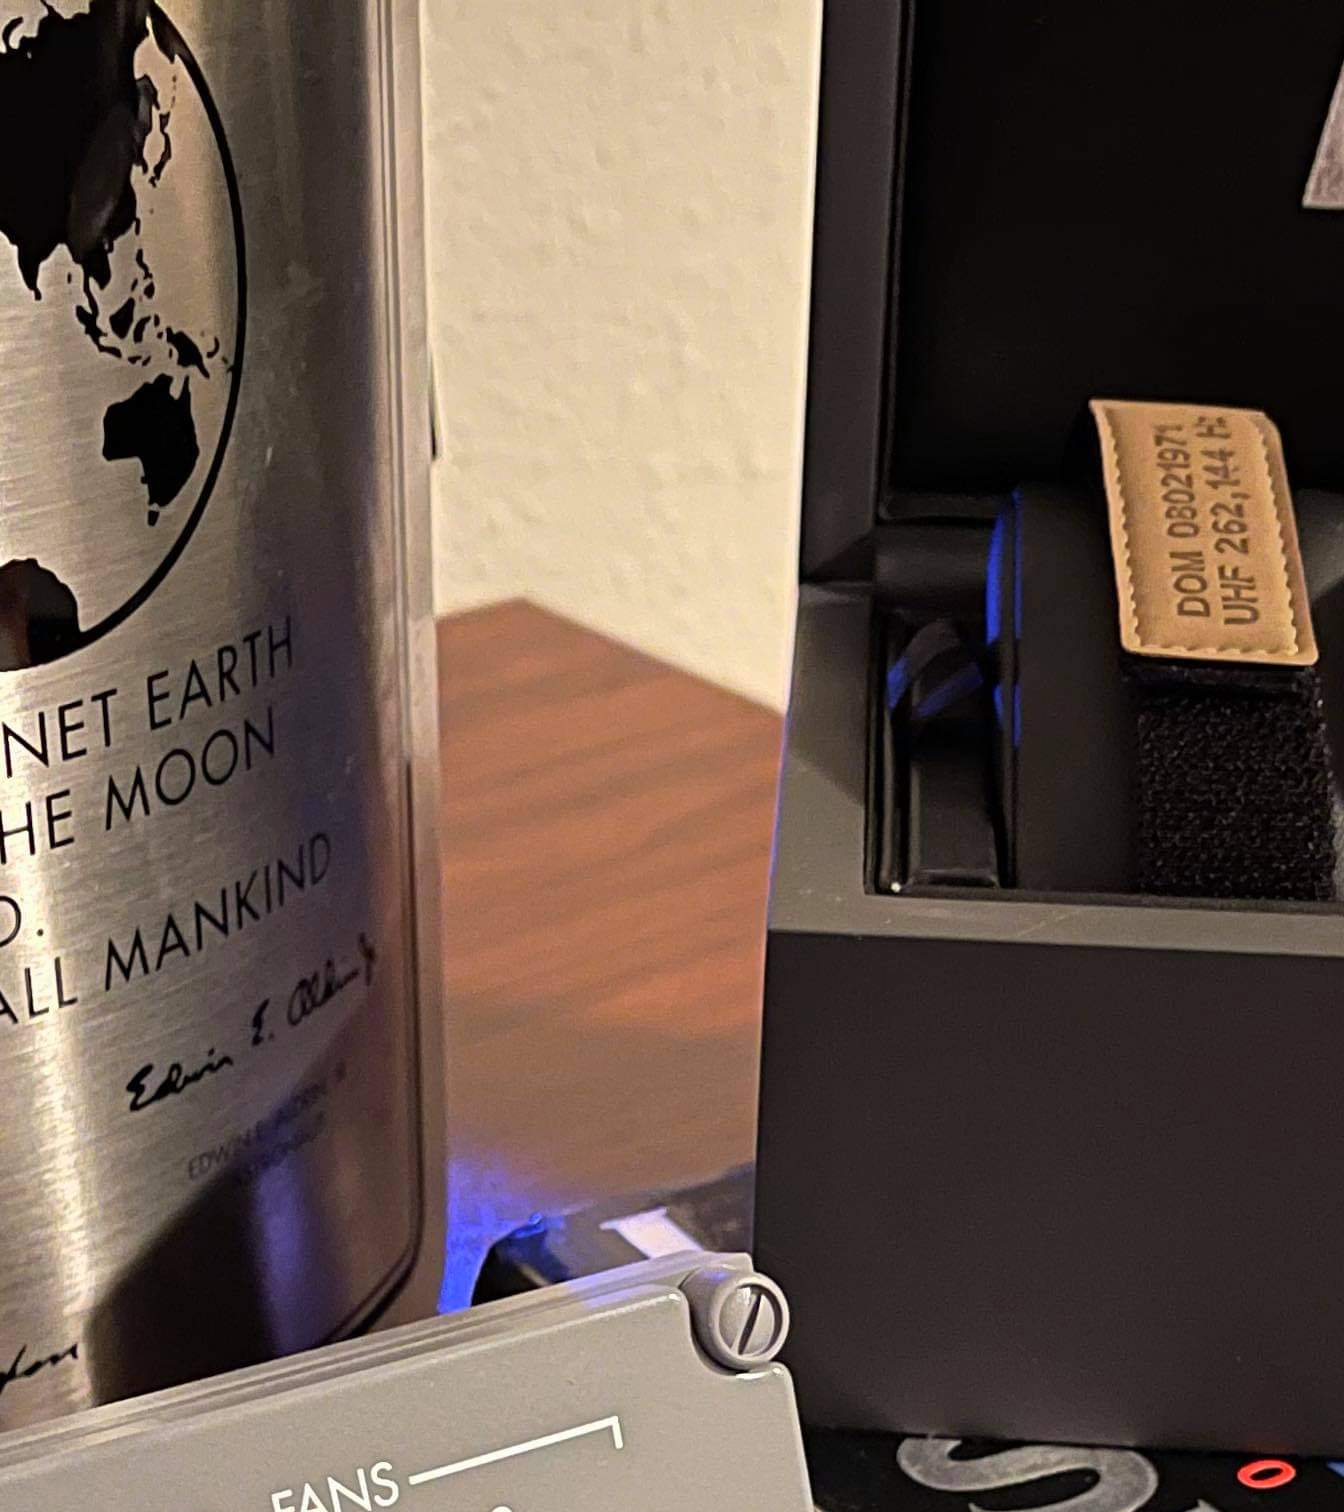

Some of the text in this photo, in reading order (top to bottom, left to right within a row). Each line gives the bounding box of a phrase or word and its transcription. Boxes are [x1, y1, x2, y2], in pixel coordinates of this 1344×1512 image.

[1154, 424, 1210, 618] DOM 08021971
[1201, 449, 1250, 556] 262,144
[1217, 565, 1260, 626] UHF
[145, 615, 295, 732] EARTH
[104, 705, 278, 833] MOON
[103, 830, 333, 994] MANKIND
